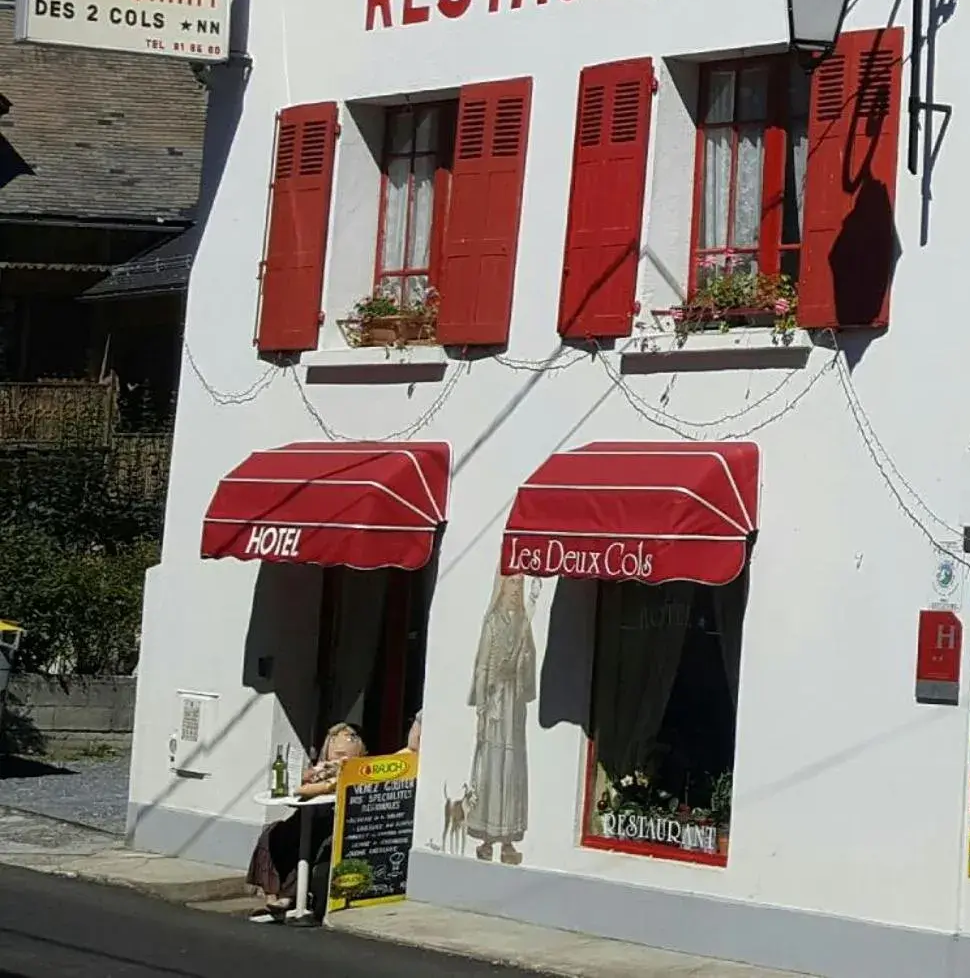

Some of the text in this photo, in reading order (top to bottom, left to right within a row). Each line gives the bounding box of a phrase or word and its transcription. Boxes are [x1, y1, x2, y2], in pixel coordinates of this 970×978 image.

[87, 5, 98, 22] 2
[110, 8, 165, 29] COLS
[146, 38, 165, 50] TEL
[245, 526, 302, 557] HOTEL
[508, 538, 653, 577] Les Deux Cols
[603, 812, 717, 851] RESTAURANT
